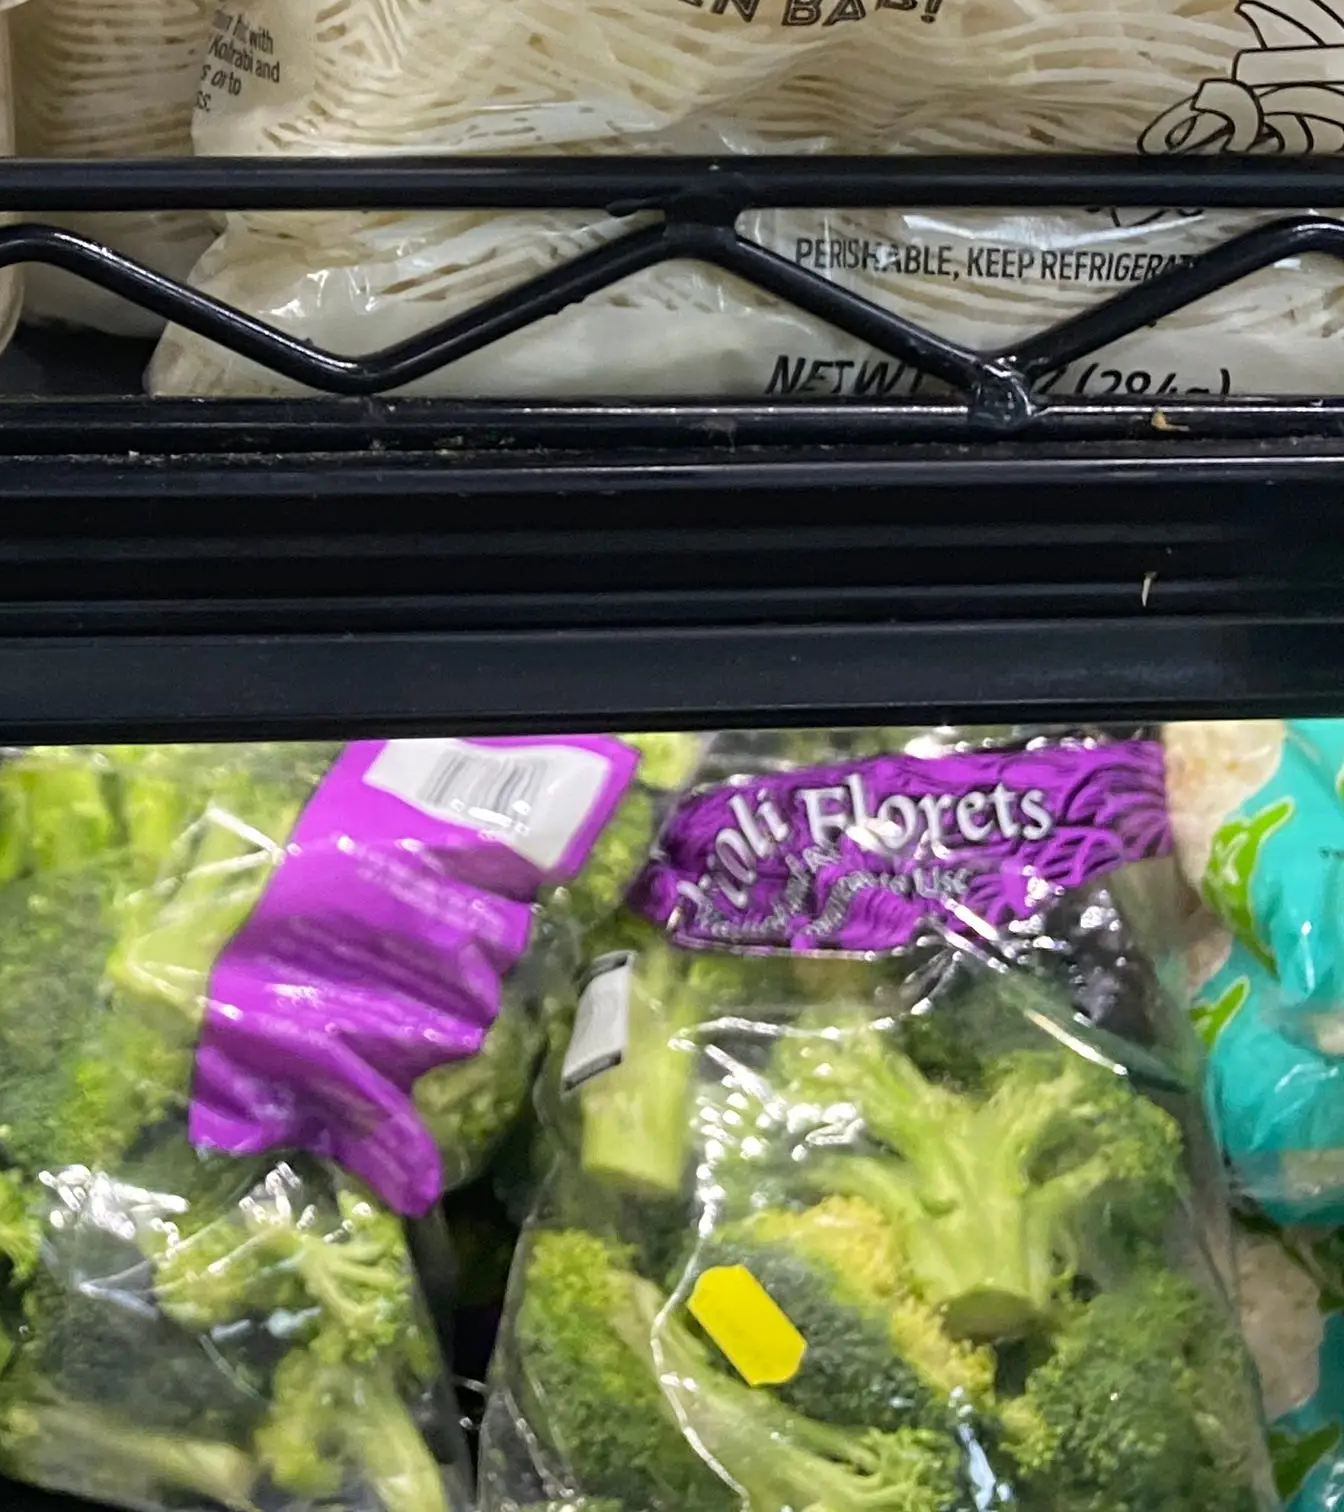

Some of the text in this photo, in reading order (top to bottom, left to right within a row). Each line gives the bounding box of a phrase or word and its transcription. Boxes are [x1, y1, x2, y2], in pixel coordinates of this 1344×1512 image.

[255, 60, 280, 83] and
[966, 247, 1035, 281] KEEP
[798, 772, 1055, 850] Florets
